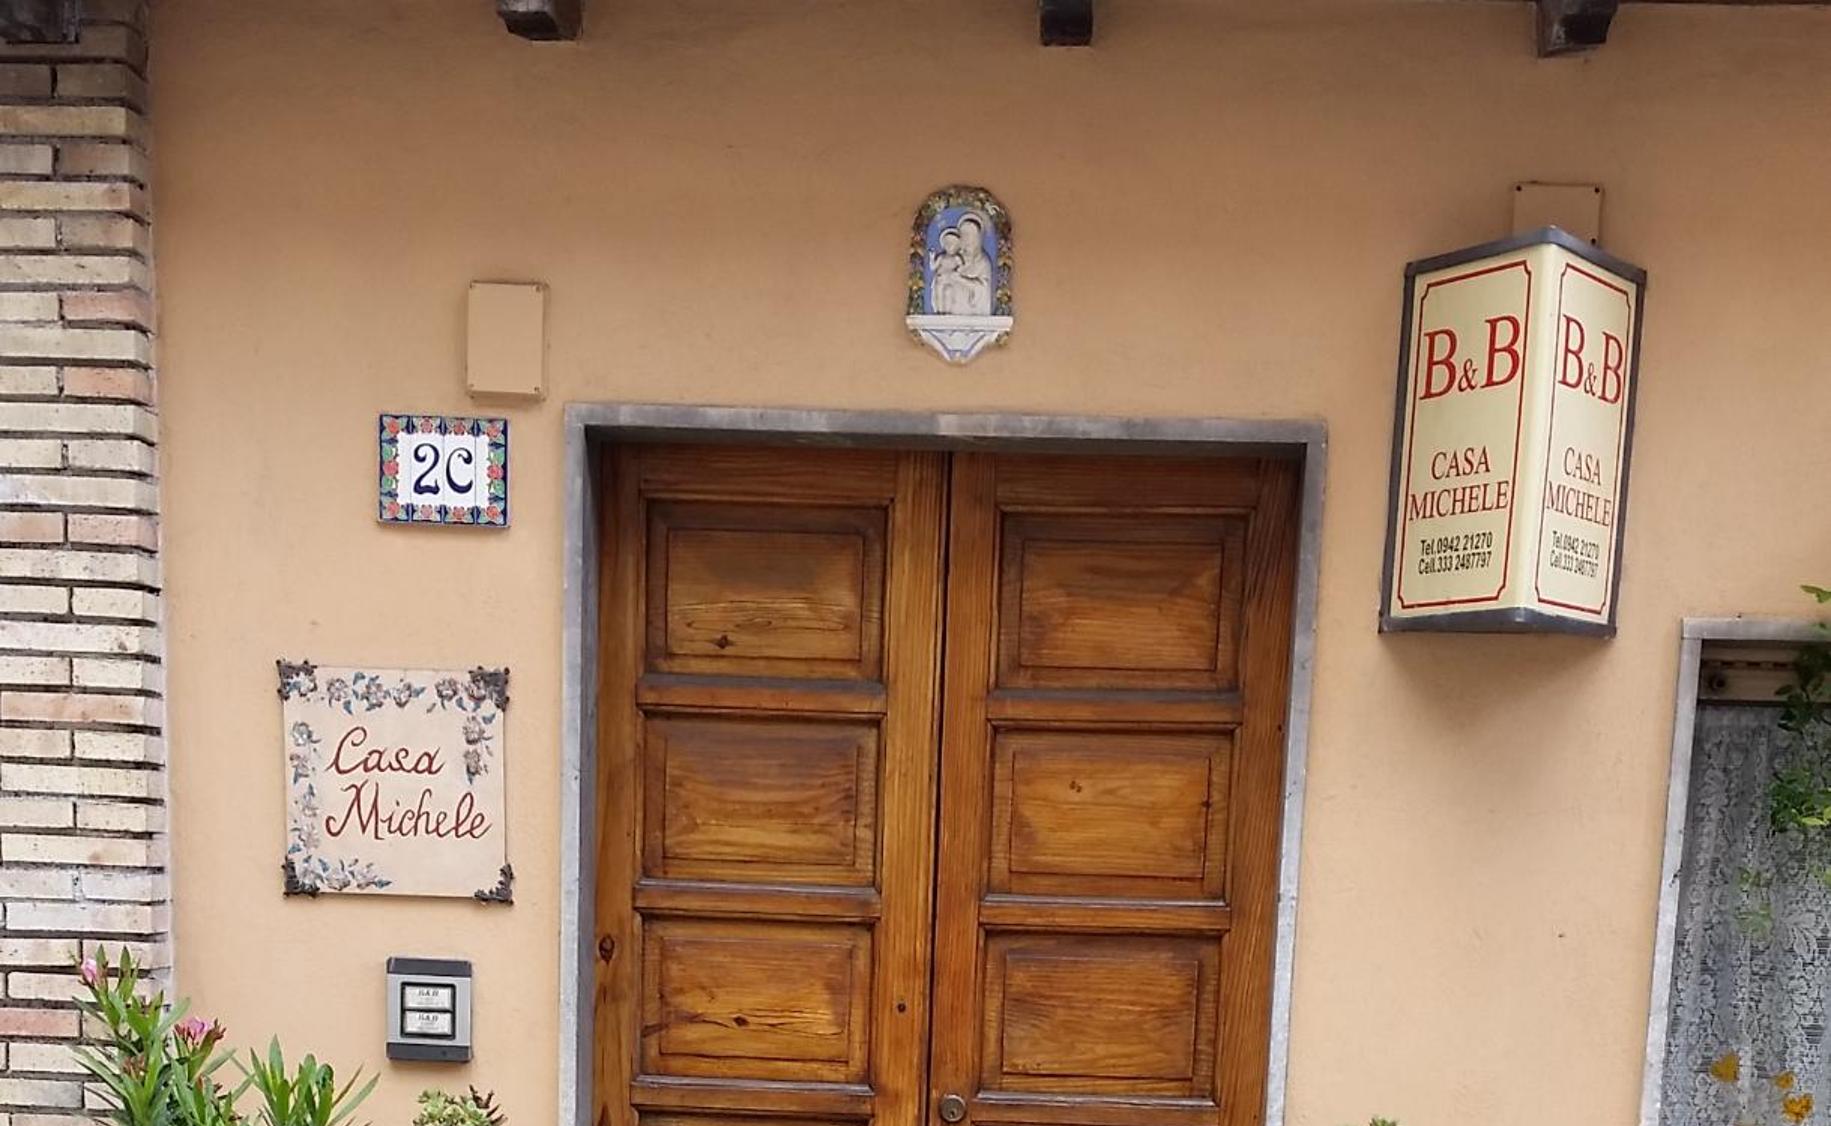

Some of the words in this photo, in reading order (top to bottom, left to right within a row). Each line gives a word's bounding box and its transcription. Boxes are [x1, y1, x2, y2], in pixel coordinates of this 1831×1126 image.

[1419, 313, 1522, 401] B&B
[1557, 312, 1626, 405] B&B
[413, 442, 473, 495] 2C
[1431, 445, 1491, 480] CASA
[1564, 446, 1602, 486] CASA
[1408, 480, 1510, 522] MICHELE
[1546, 480, 1612, 527] MICHELE
[1454, 551, 1493, 571] 2487797
[1462, 531, 1494, 551] 21270
[325, 725, 446, 777] Casa
[325, 780, 493, 842] Michele
